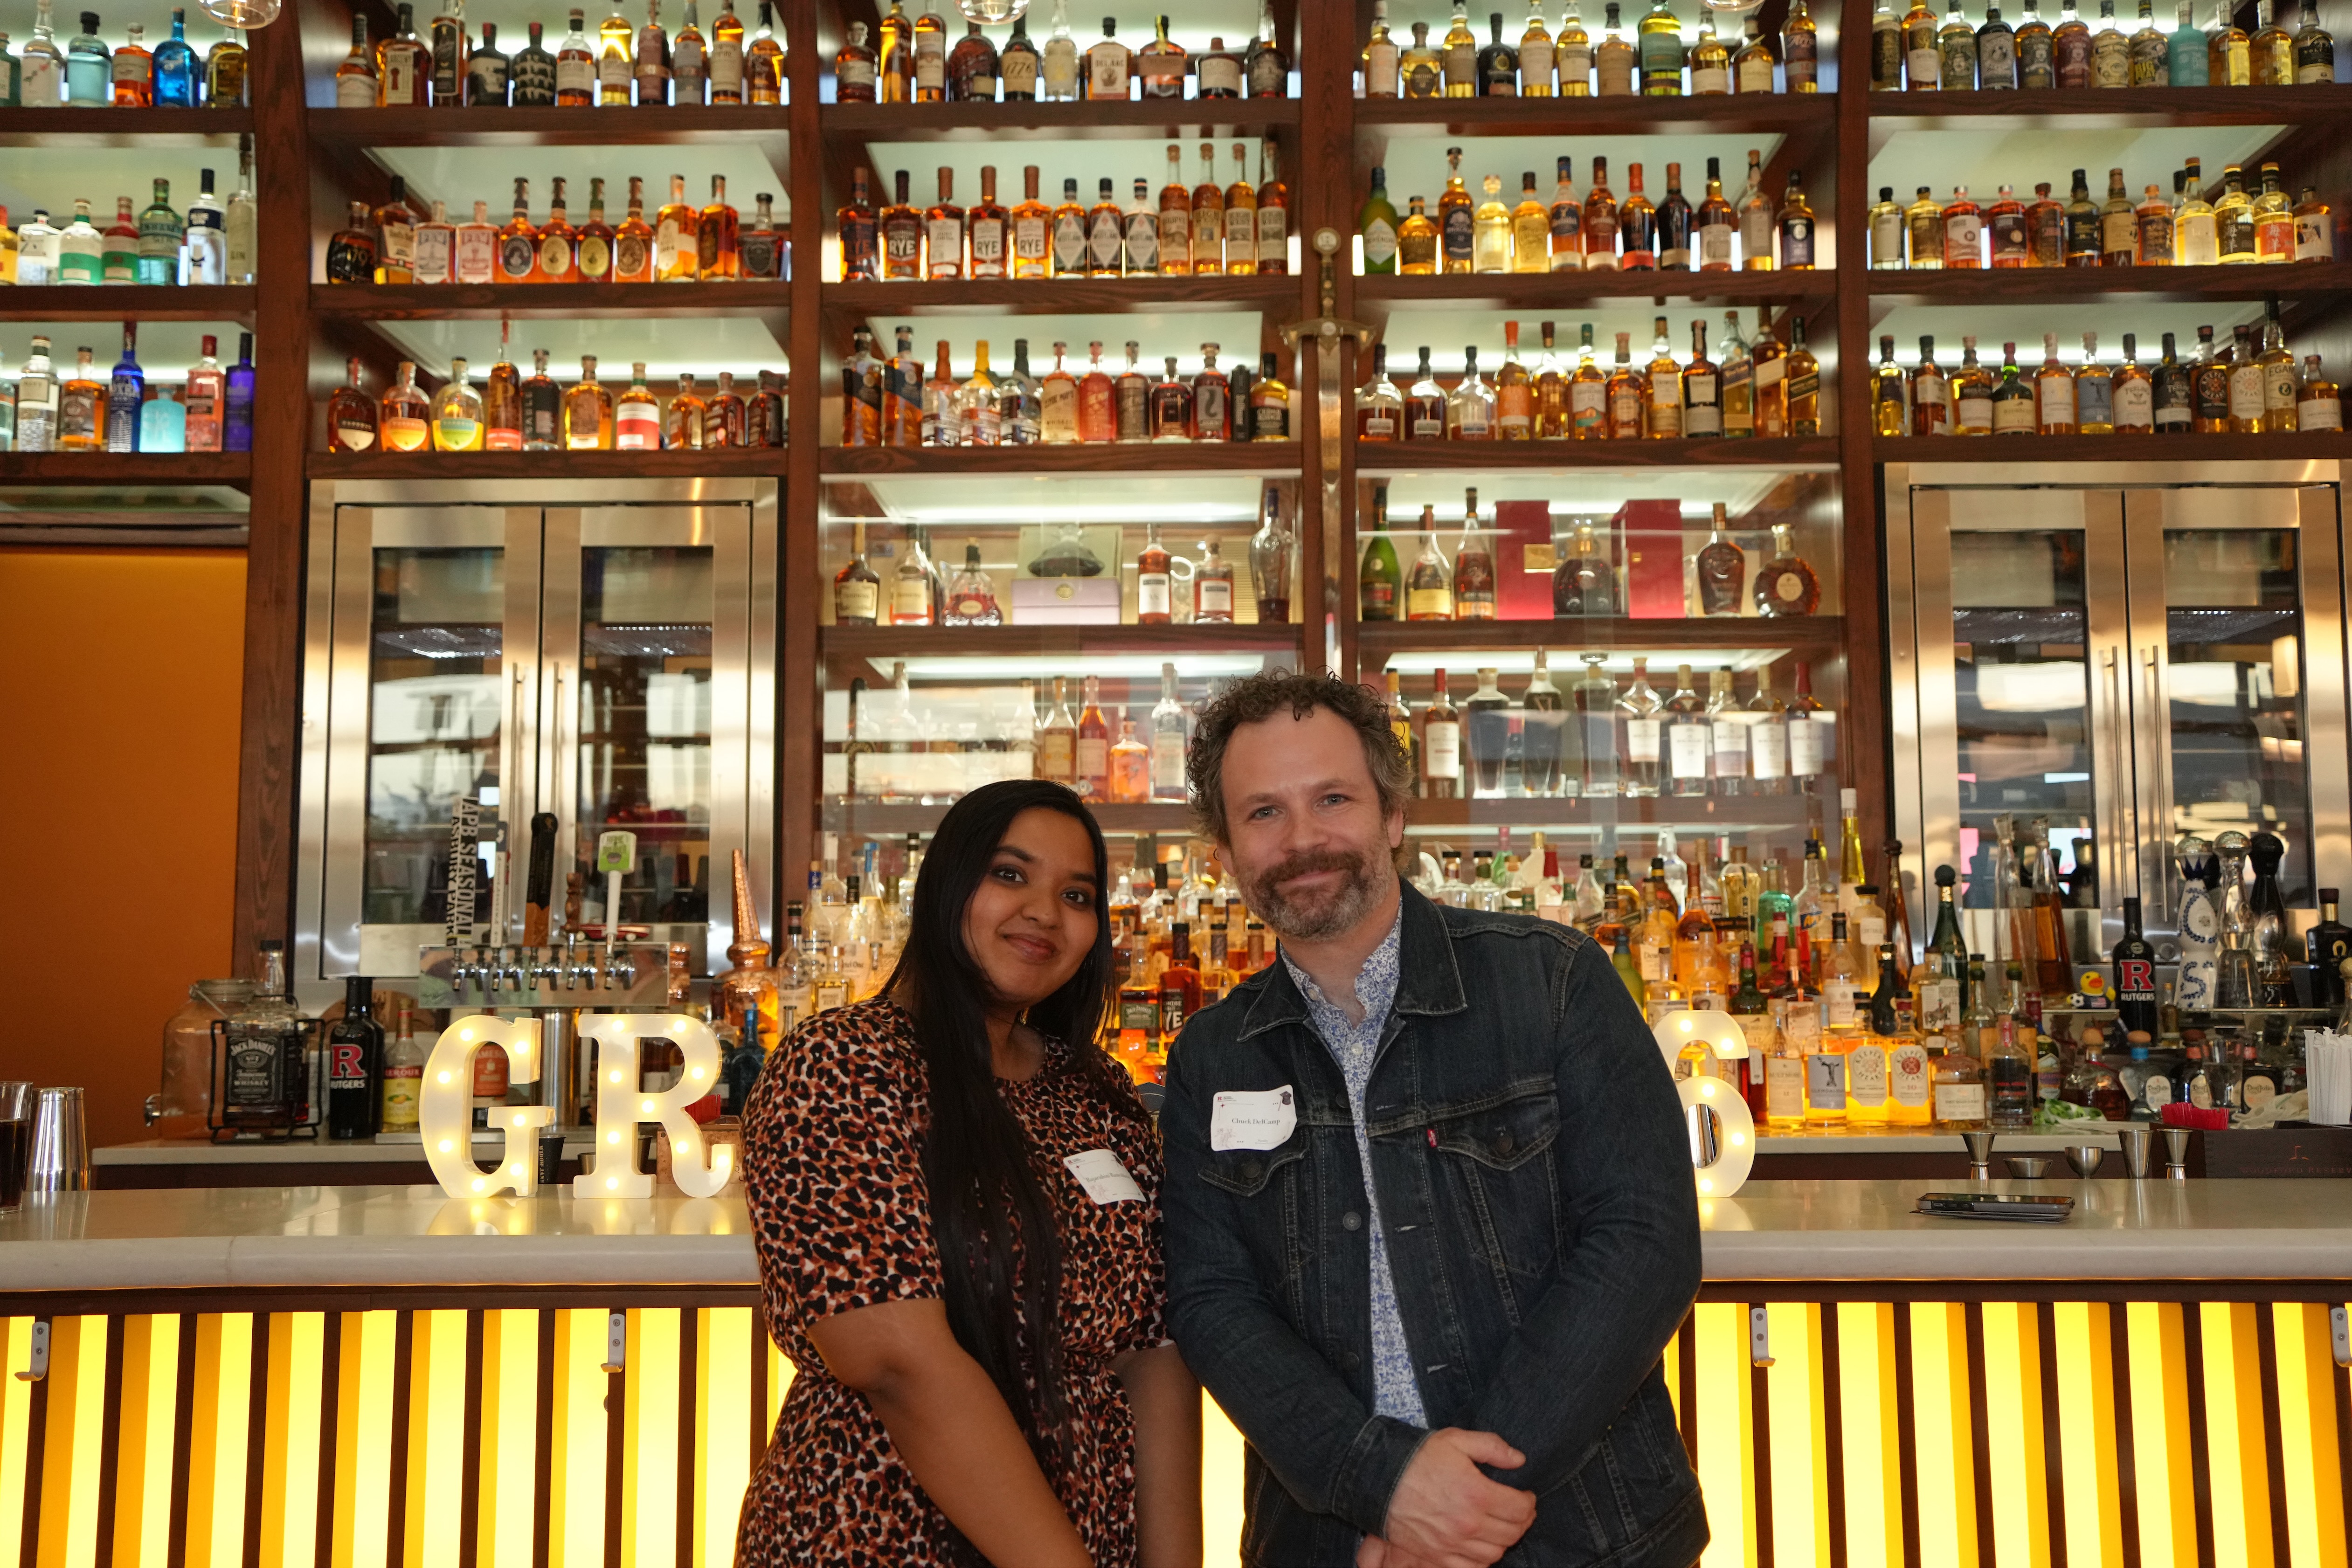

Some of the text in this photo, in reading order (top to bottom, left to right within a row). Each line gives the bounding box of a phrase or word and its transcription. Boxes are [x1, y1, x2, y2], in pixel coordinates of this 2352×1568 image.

[1004, 61, 1035, 76] 1776
[888, 240, 916, 256] RYE
[976, 240, 998, 256] RYE
[1019, 238, 1043, 254] RYE
[446, 816, 460, 935] ASBURY PARK
[457, 842, 477, 935] SEASONAL
[2120, 959, 2154, 992] R
[2121, 993, 2155, 1001] RUTGERS
[1163, 1011, 1183, 1031] YE
[331, 1043, 366, 1078] R
